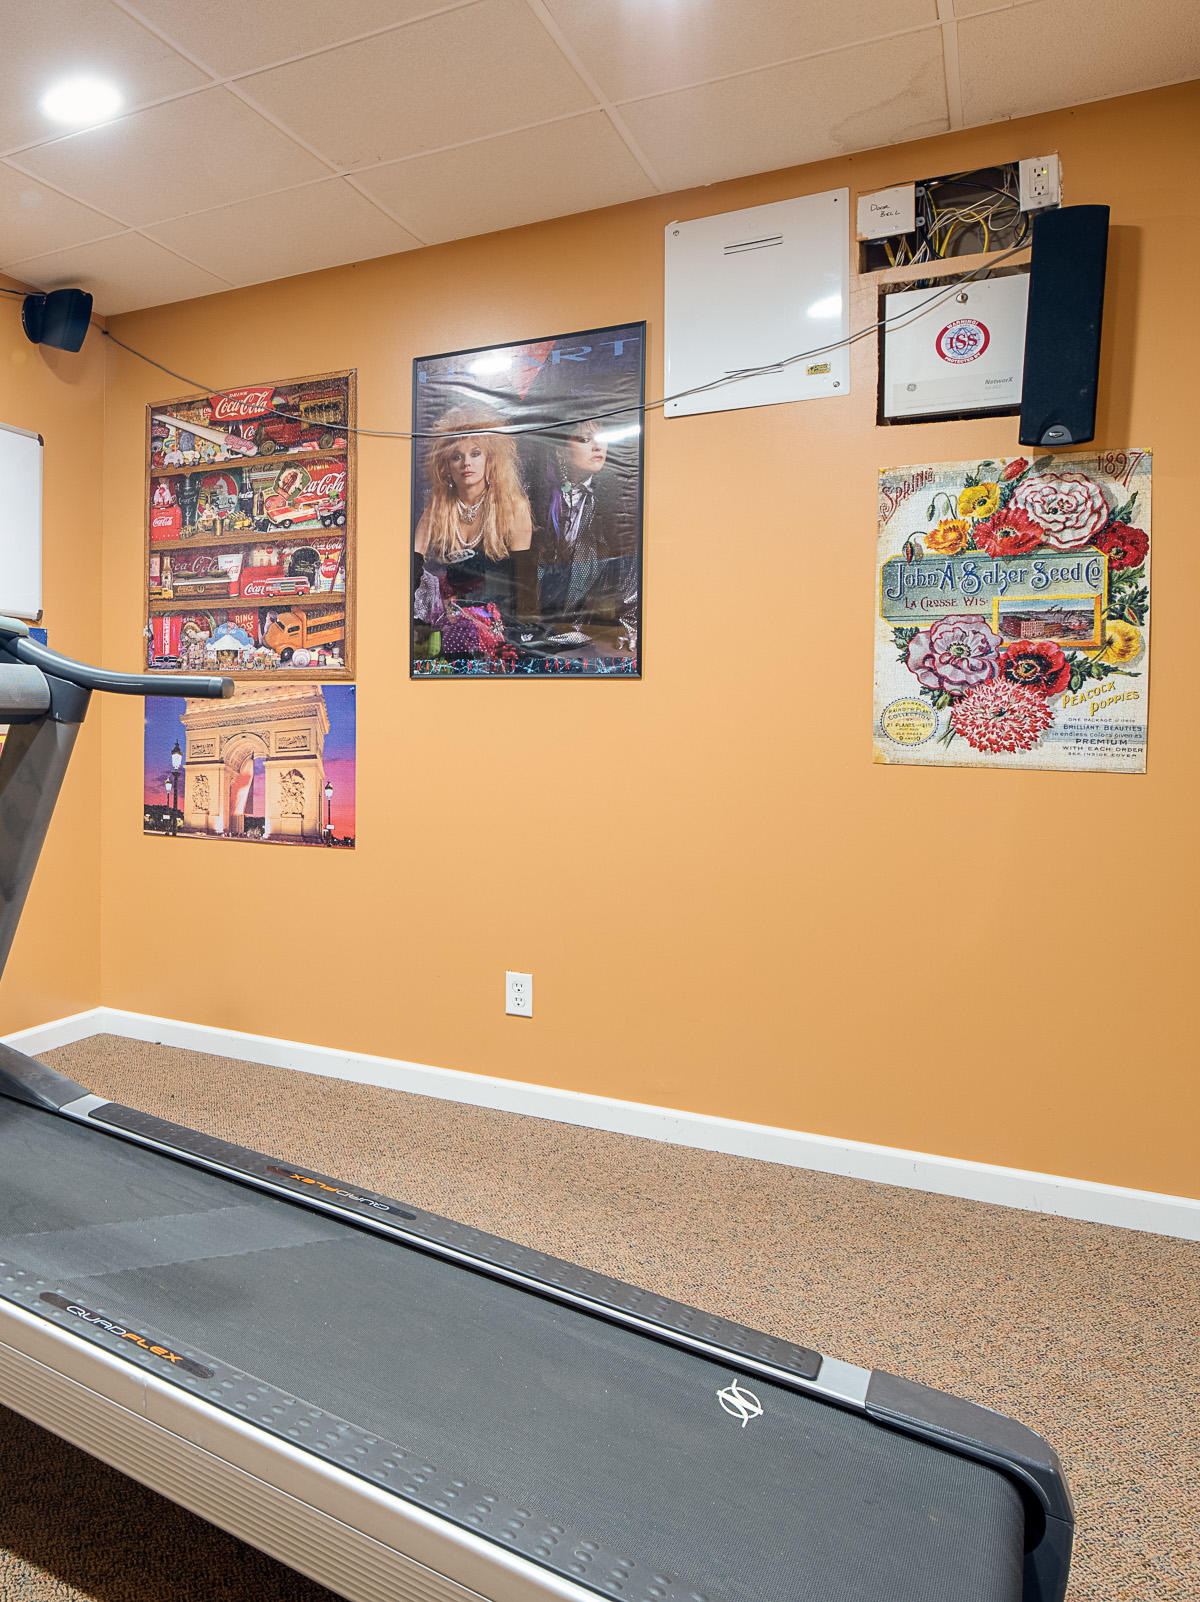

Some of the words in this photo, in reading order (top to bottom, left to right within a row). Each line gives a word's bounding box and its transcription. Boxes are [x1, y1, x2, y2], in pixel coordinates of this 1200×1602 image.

[948, 333, 978, 350] ISS
[1097, 451, 1144, 488] 1897
[886, 563, 940, 599] John
[960, 560, 1028, 596] Salzer
[1030, 560, 1081, 590] Seed
[235, 613, 254, 624] RING
[1062, 680, 1116, 709] PEACOCK
[1090, 690, 1140, 717] POPPIES
[1103, 724, 1142, 732] BEAUTIES
[1075, 738, 1128, 746] PREMIUM
[66, 1305, 184, 1363] QUADFLEX
